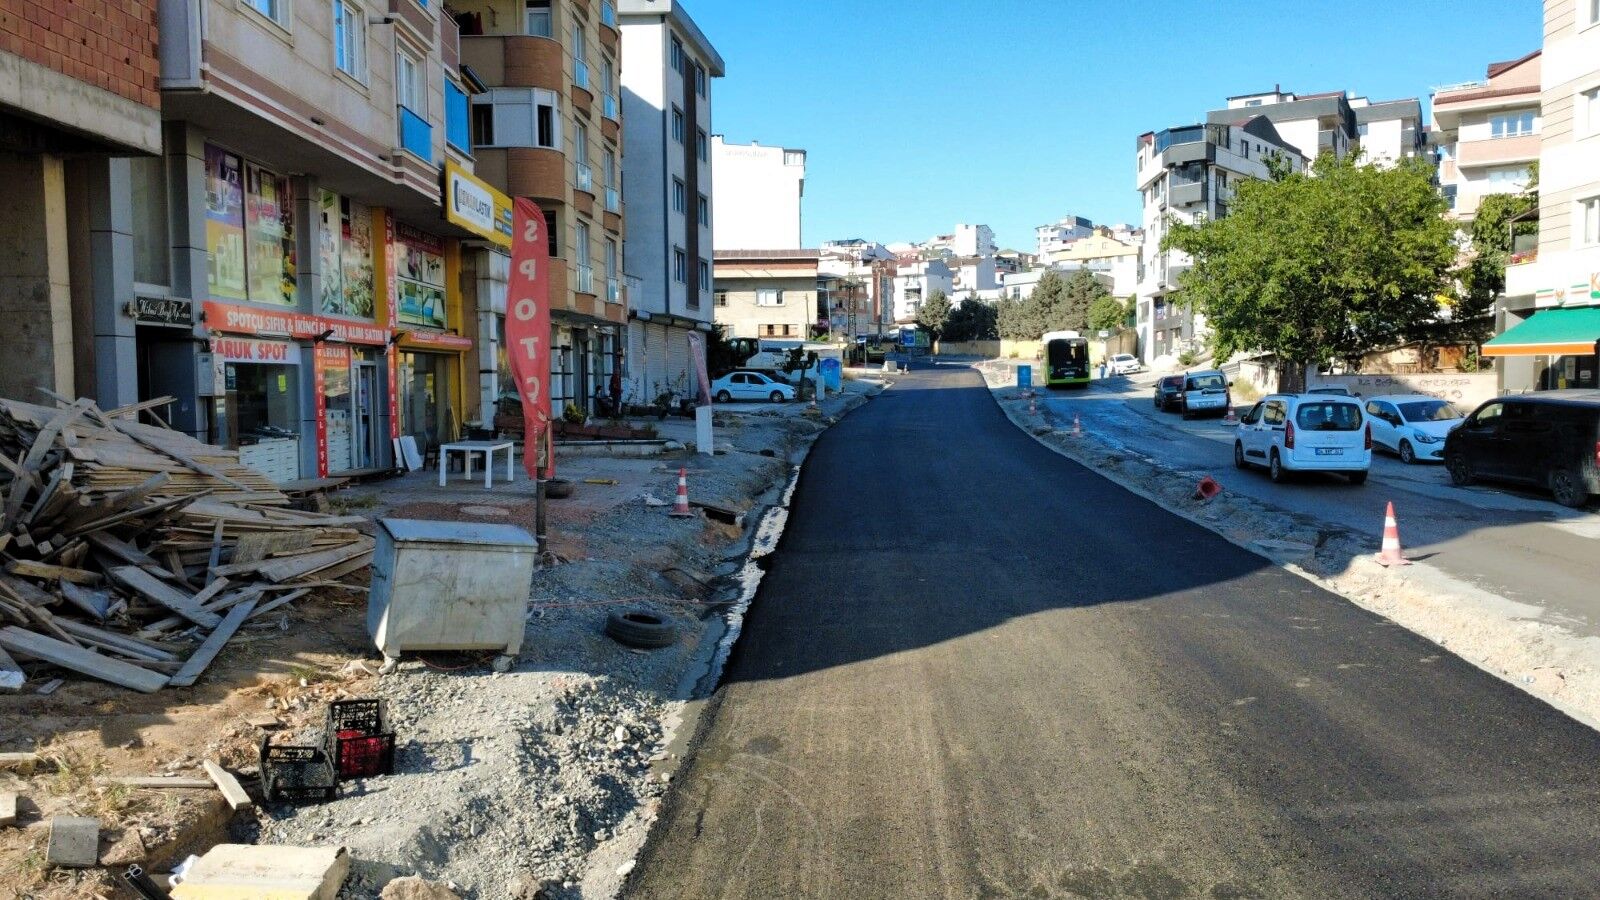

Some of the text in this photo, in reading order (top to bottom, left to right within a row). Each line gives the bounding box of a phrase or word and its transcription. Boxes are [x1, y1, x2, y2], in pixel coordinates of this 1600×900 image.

[227, 311, 263, 330] SPOTÇU
[265, 316, 286, 331] SIFIR
[364, 329, 384, 342] SATIM
[257, 343, 288, 360] SPOT
